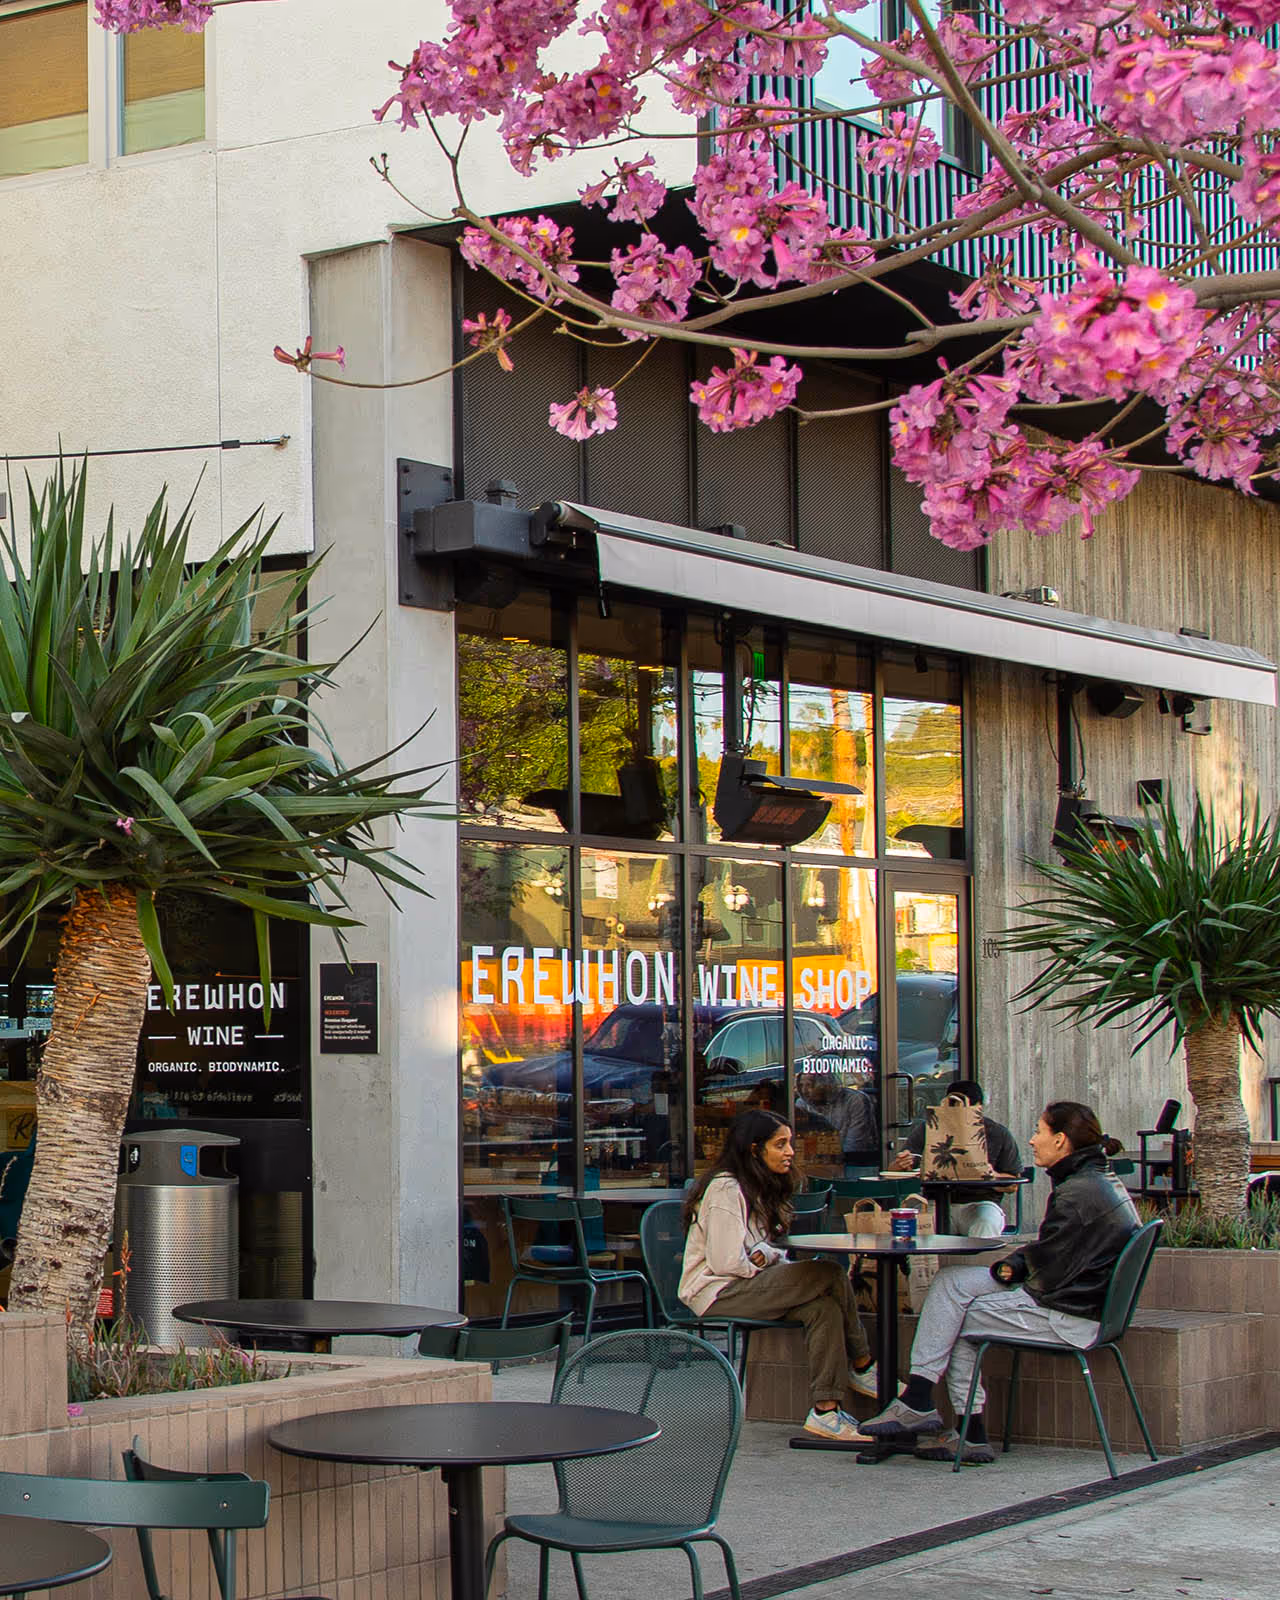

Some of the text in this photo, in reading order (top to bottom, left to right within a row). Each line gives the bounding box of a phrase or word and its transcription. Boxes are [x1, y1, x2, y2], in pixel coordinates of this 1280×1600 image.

[472, 945, 872, 1010] EREWHON WINE SHOP
[147, 982, 285, 1011] EREWHON
[187, 1026, 244, 1046] WINE
[822, 1035, 872, 1050] ORGANIC.
[148, 1061, 285, 1073] ORGANIC. BIODYNAMIC.
